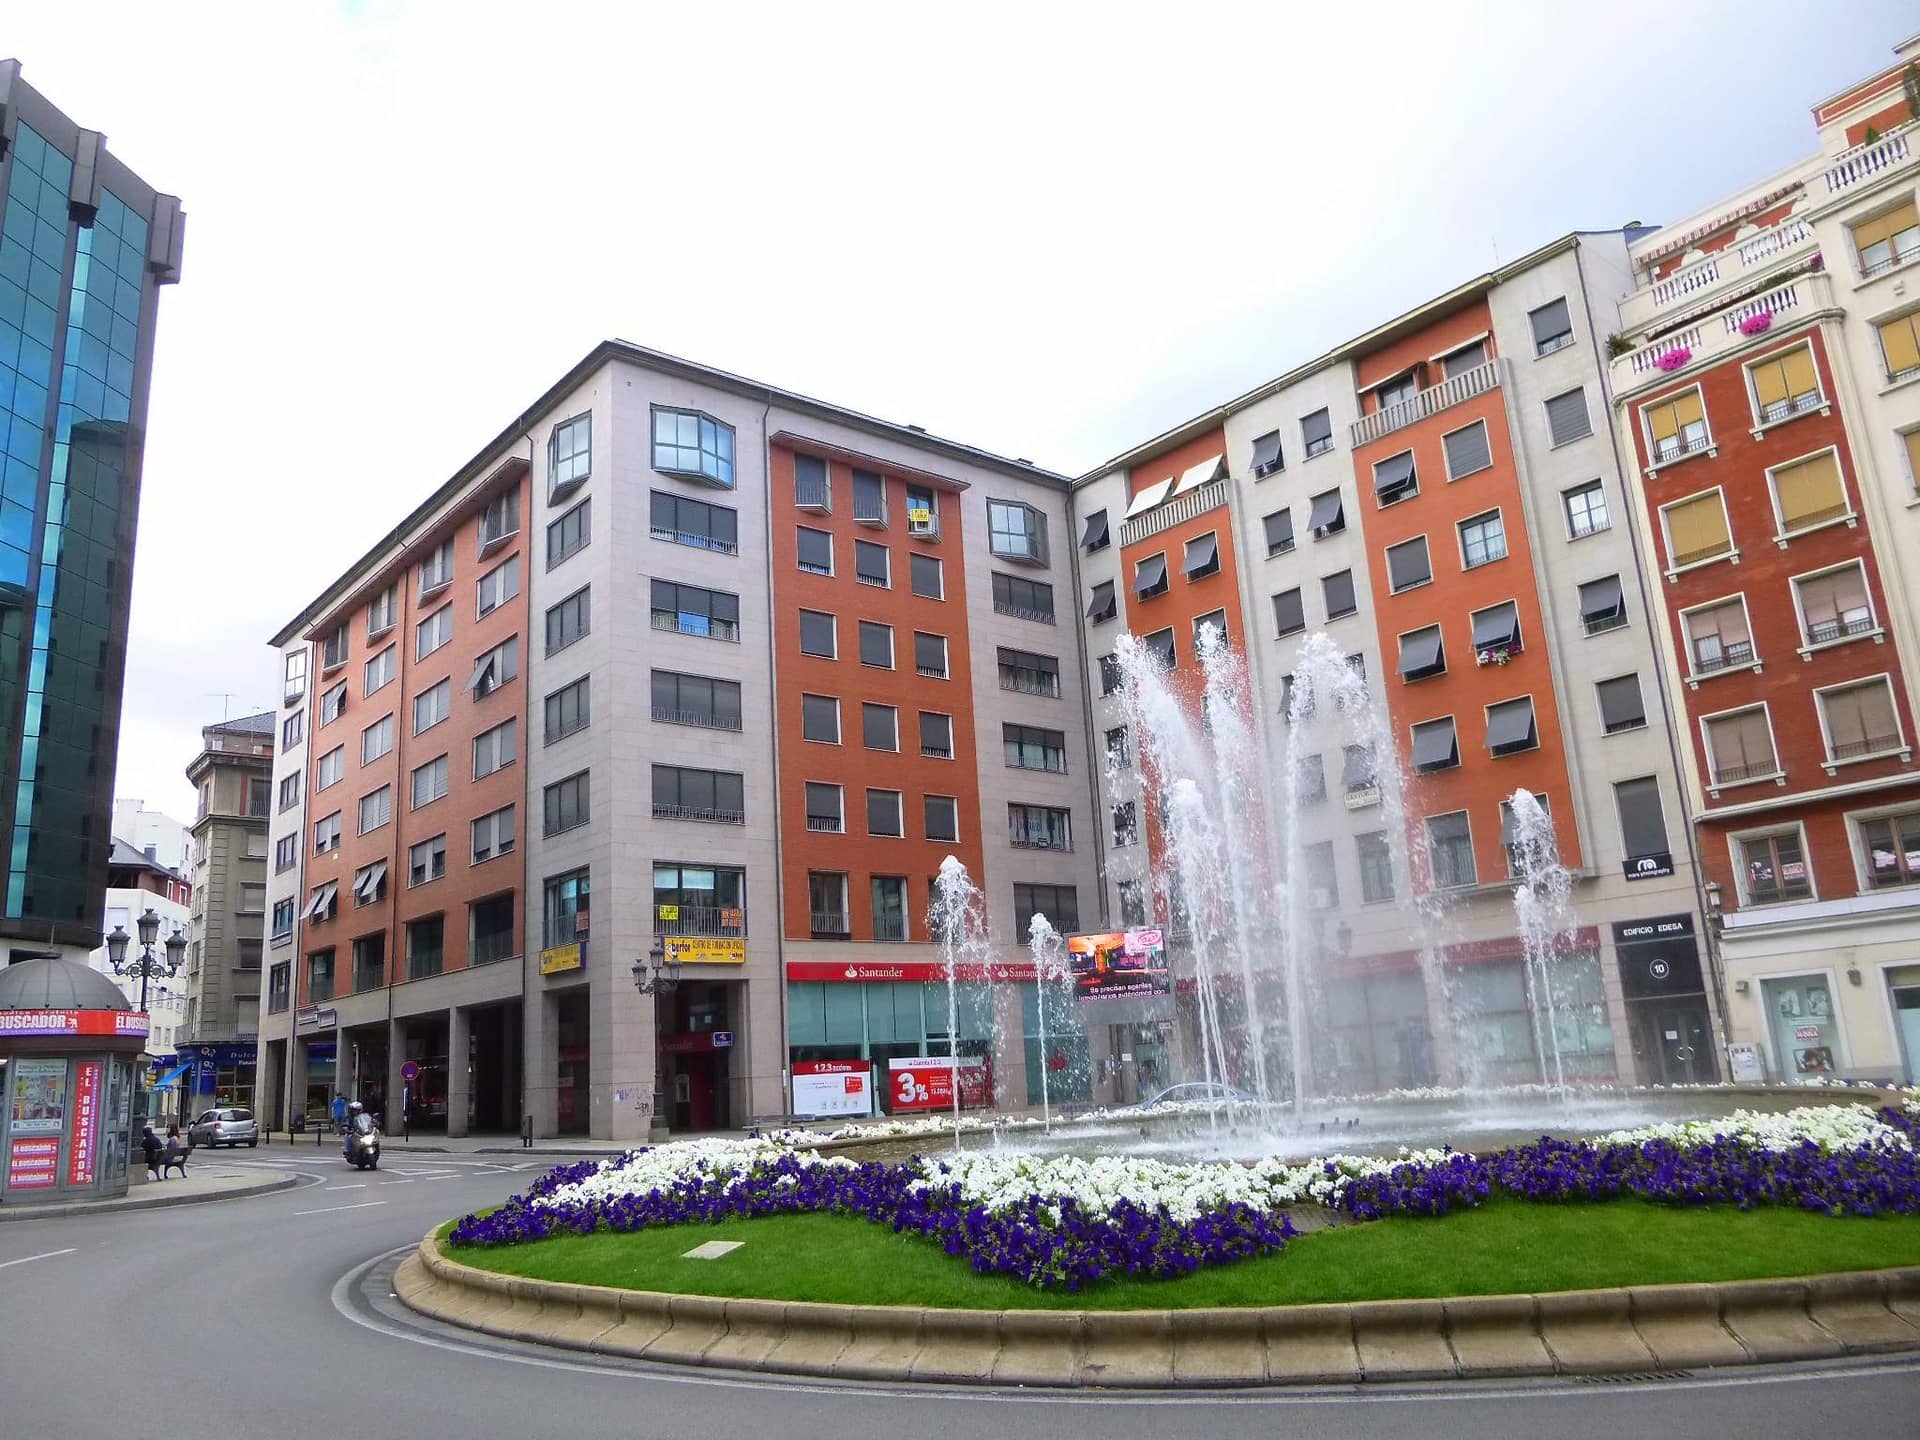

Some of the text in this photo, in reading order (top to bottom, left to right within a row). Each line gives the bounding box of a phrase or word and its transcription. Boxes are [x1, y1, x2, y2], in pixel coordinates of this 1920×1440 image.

[1624, 922, 1683, 936] EDIFICIO EDESA
[859, 966, 903, 977] Santander
[1654, 964, 1665, 974] 10
[84, 1067, 93, 1086] EL
[77, 1096, 90, 1181] BUSCADOR
